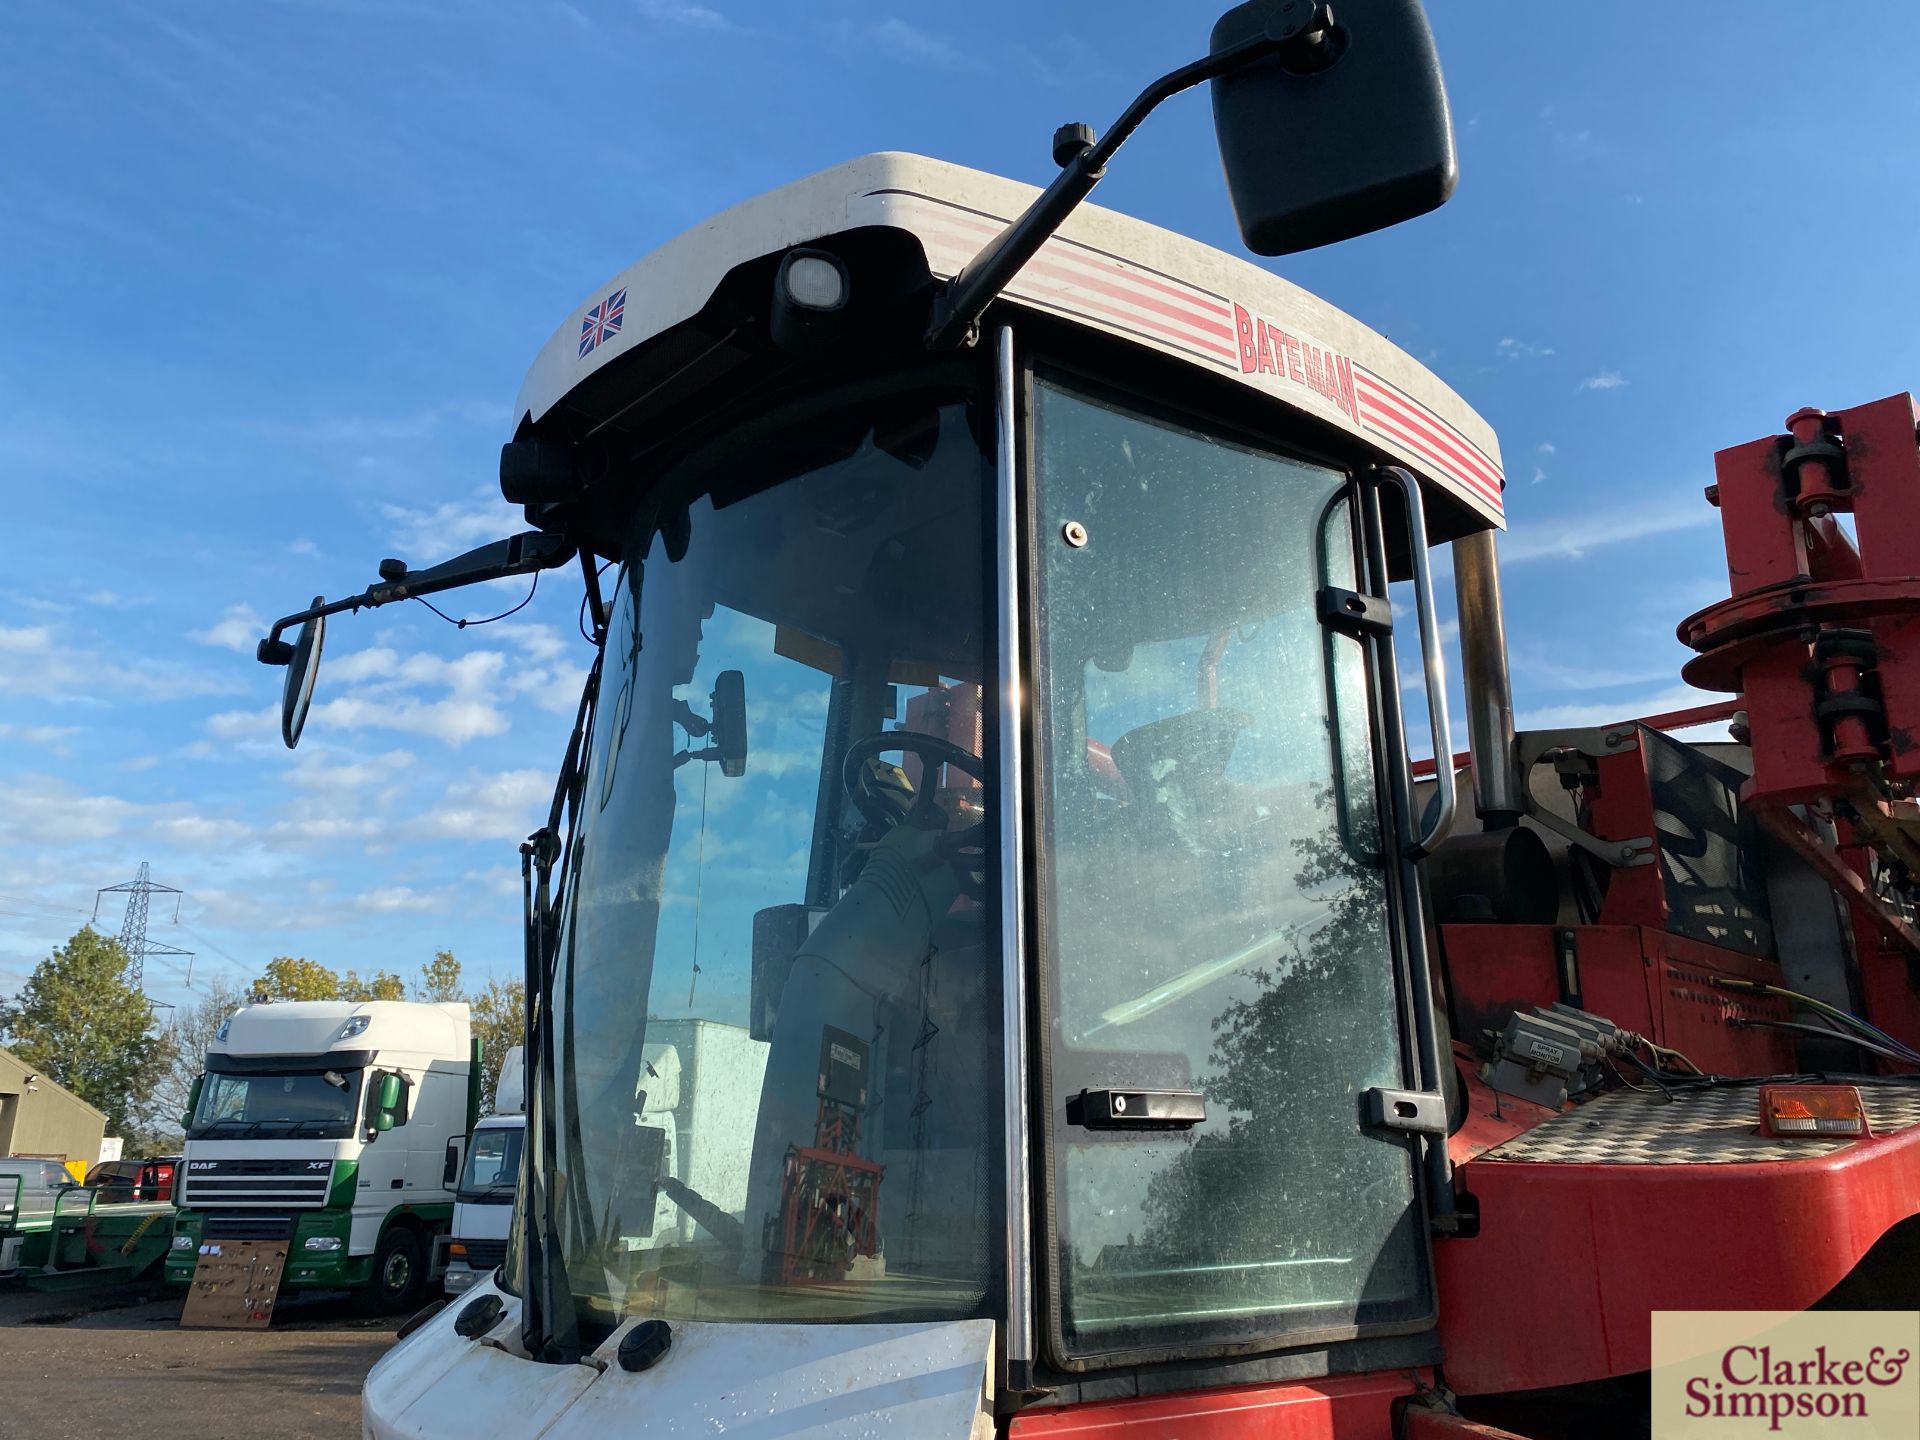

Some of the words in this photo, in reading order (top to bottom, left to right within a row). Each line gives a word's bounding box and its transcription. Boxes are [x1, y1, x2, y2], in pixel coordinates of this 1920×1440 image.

[1234, 302, 1360, 426] BATEMAN
[1531, 1049, 1560, 1062] MONITOR
[1537, 1044, 1558, 1055] SPRAY
[190, 1162, 217, 1170] DAF
[307, 1162, 330, 1170] XF
